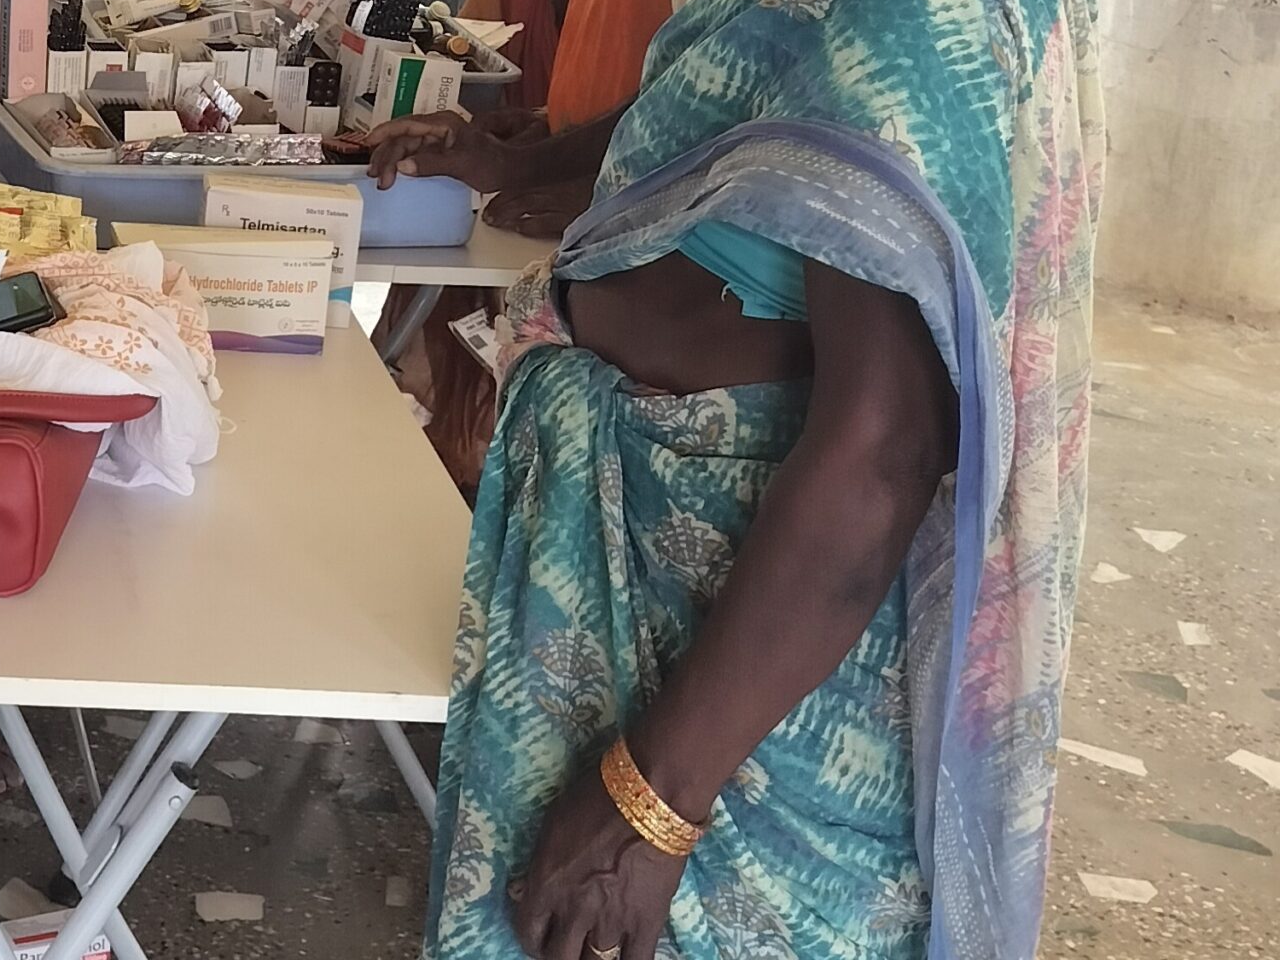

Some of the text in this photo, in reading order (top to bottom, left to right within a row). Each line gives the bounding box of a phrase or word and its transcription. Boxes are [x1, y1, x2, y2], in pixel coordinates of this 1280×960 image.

[437, 76, 454, 112] Bisaco
[240, 217, 327, 236] Telmisartan
[189, 275, 319, 294] Hydrochloride Tablets IP
